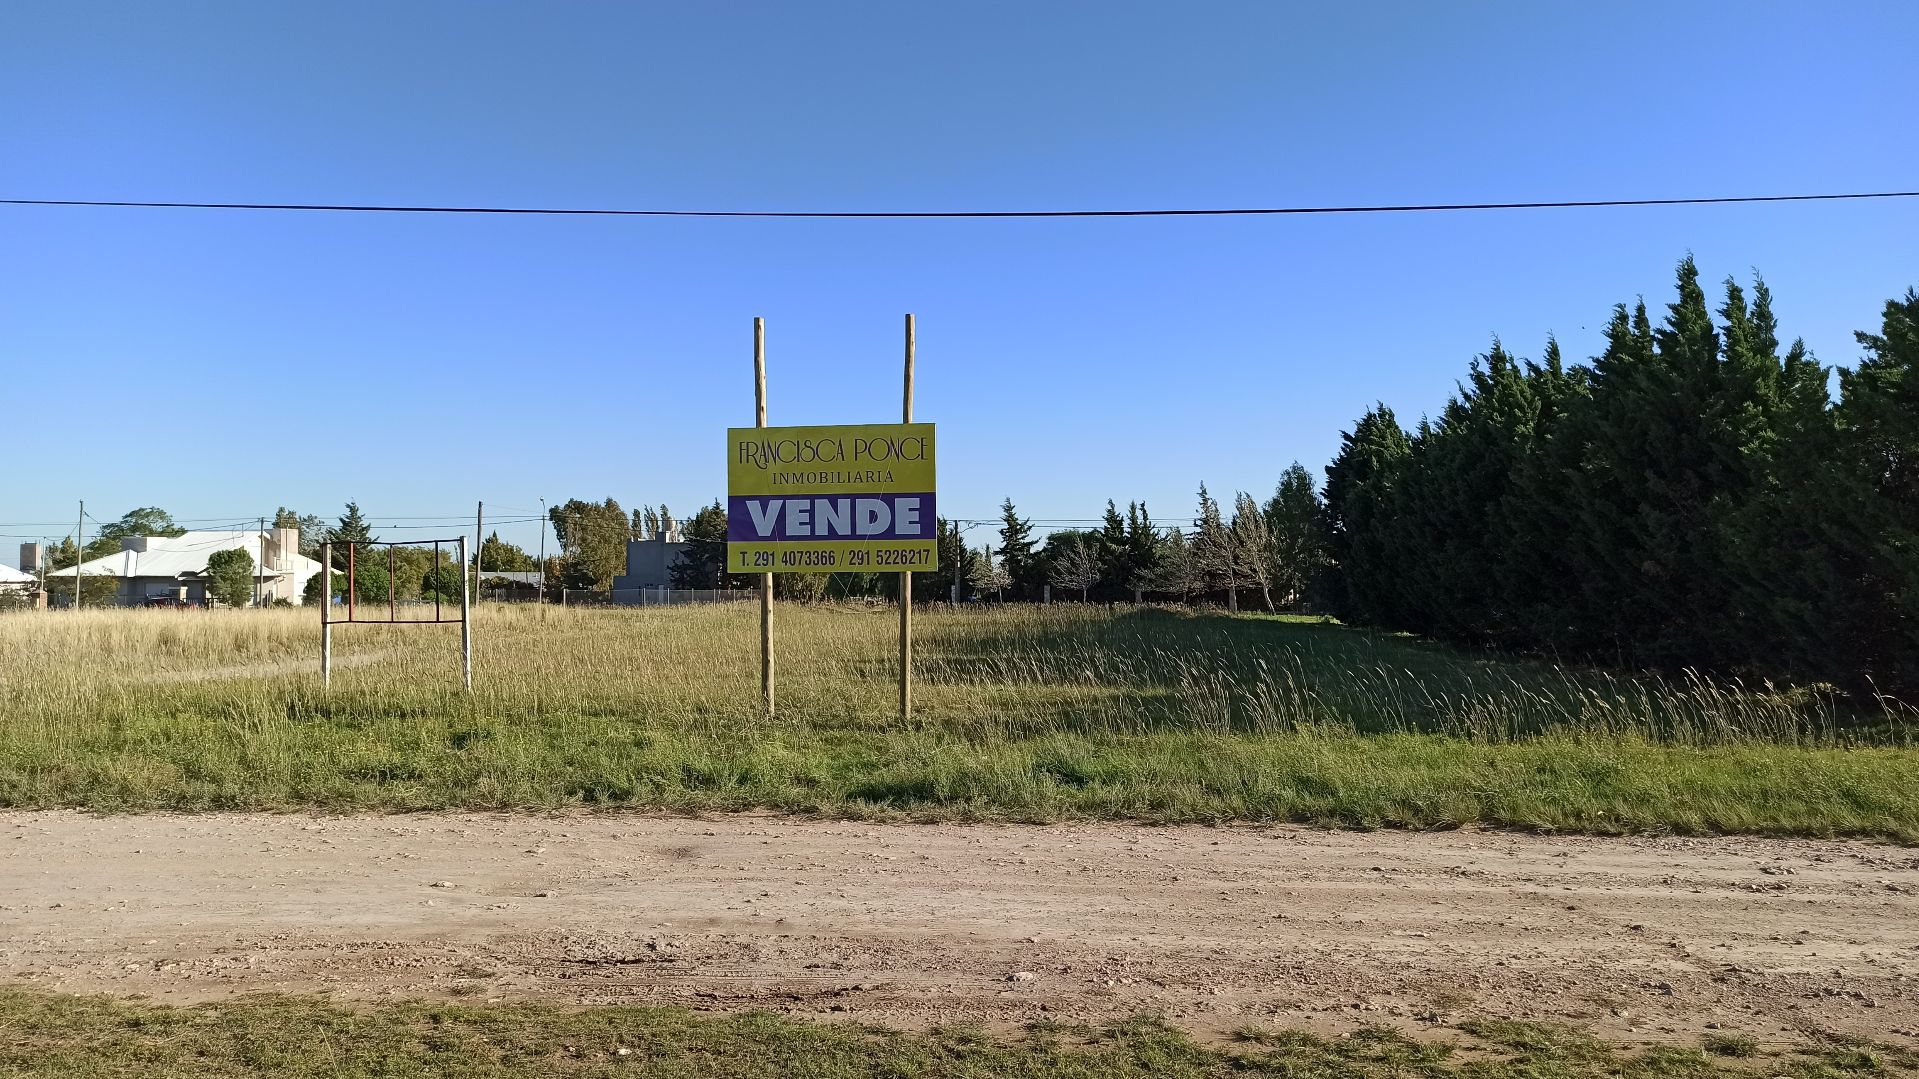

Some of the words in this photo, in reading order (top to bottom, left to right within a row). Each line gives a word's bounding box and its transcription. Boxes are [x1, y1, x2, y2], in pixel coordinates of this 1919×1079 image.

[739, 438, 845, 470] FRANCISCA
[854, 436, 928, 463] PONCE
[773, 470, 894, 485] INMOBILIARIA
[745, 497, 921, 537] VENDE
[739, 551, 750, 567] T.
[754, 551, 776, 567] 291
[781, 550, 835, 566] 4073366
[848, 549, 870, 566] 291
[876, 549, 930, 565] 5226217
